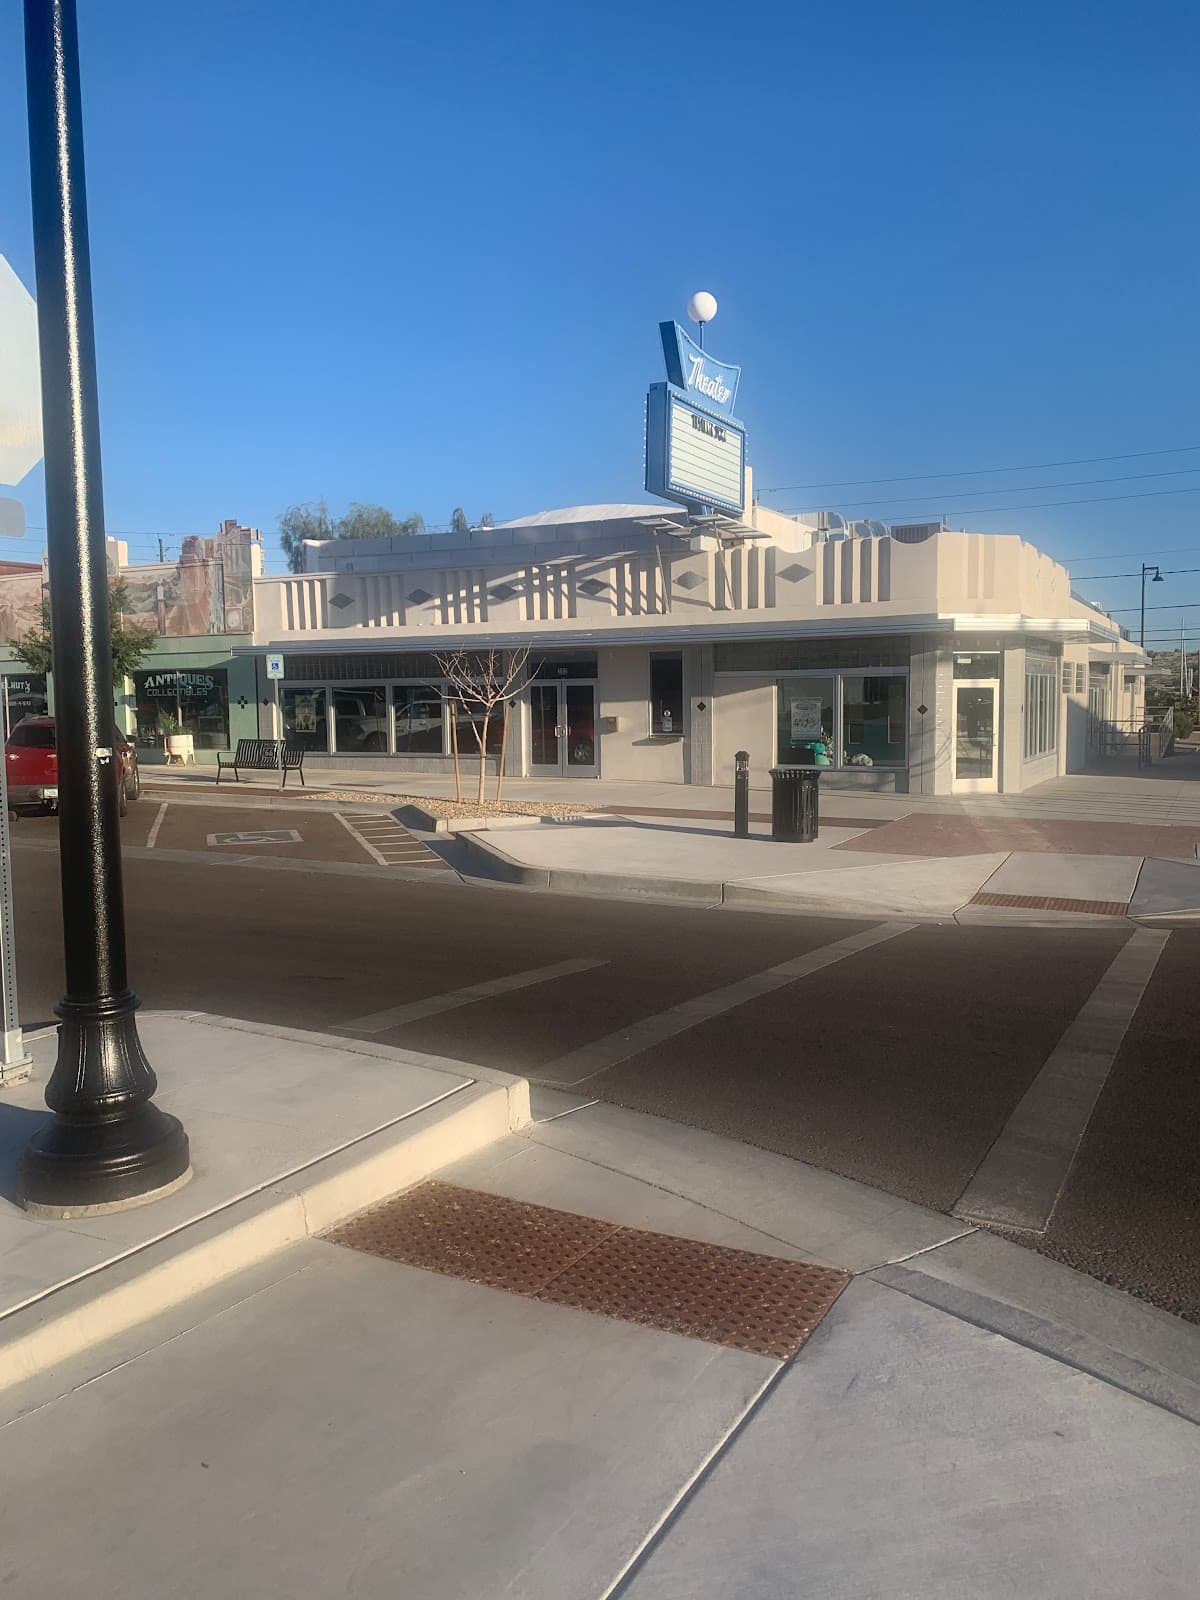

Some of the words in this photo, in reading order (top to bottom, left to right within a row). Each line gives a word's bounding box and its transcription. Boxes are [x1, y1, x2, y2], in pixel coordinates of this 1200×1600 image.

[688, 353, 731, 404] Theater
[143, 673, 214, 690] ANTIQUES
[146, 687, 208, 697] COLLECTIBLES
